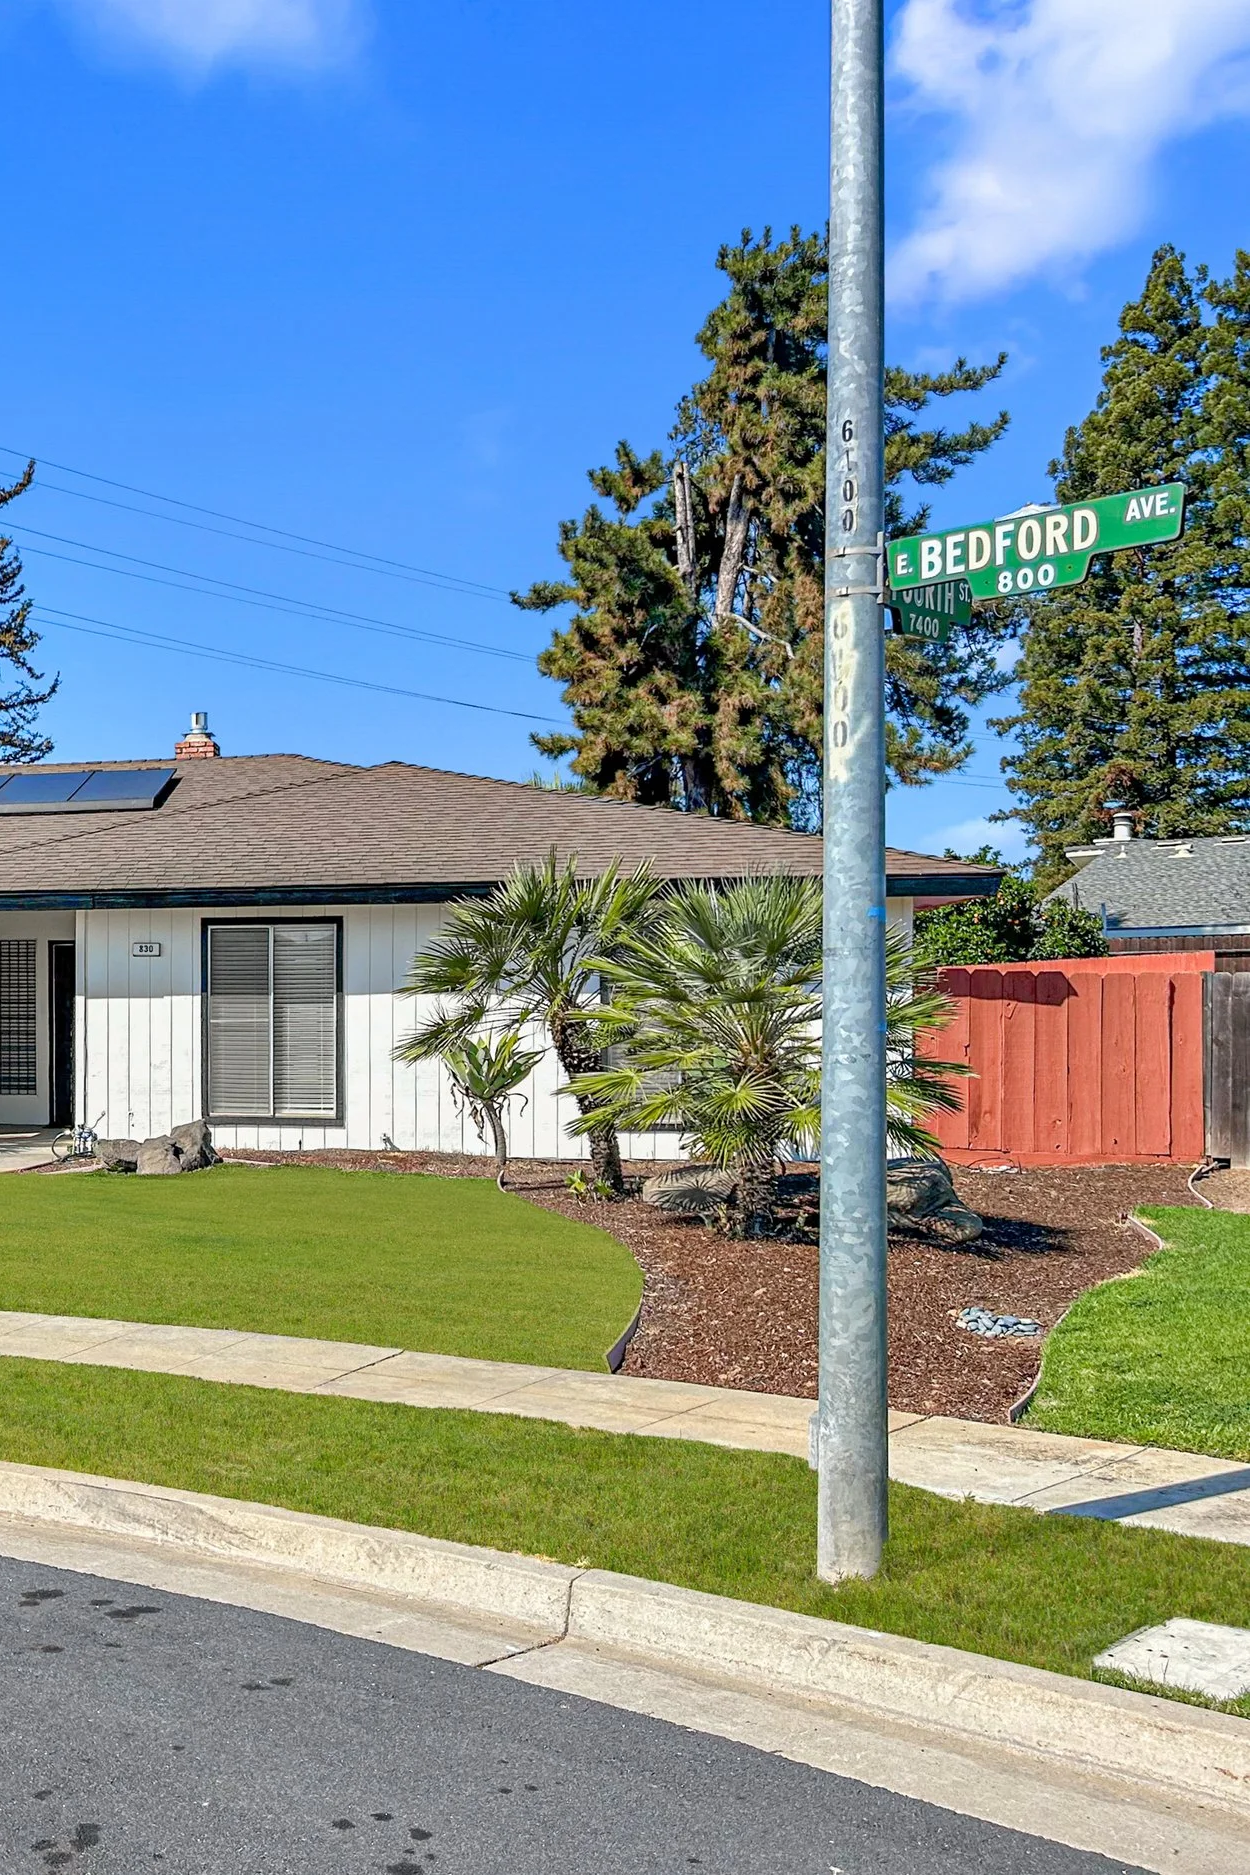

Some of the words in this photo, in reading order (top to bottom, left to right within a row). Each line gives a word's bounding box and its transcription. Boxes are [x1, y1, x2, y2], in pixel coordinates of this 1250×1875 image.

[896, 553, 913, 576] E.
[920, 509, 1098, 580] BEDFORD
[1125, 492, 1176, 522] AVE.
[997, 563, 1055, 594] 800
[909, 613, 939, 638] 7400
